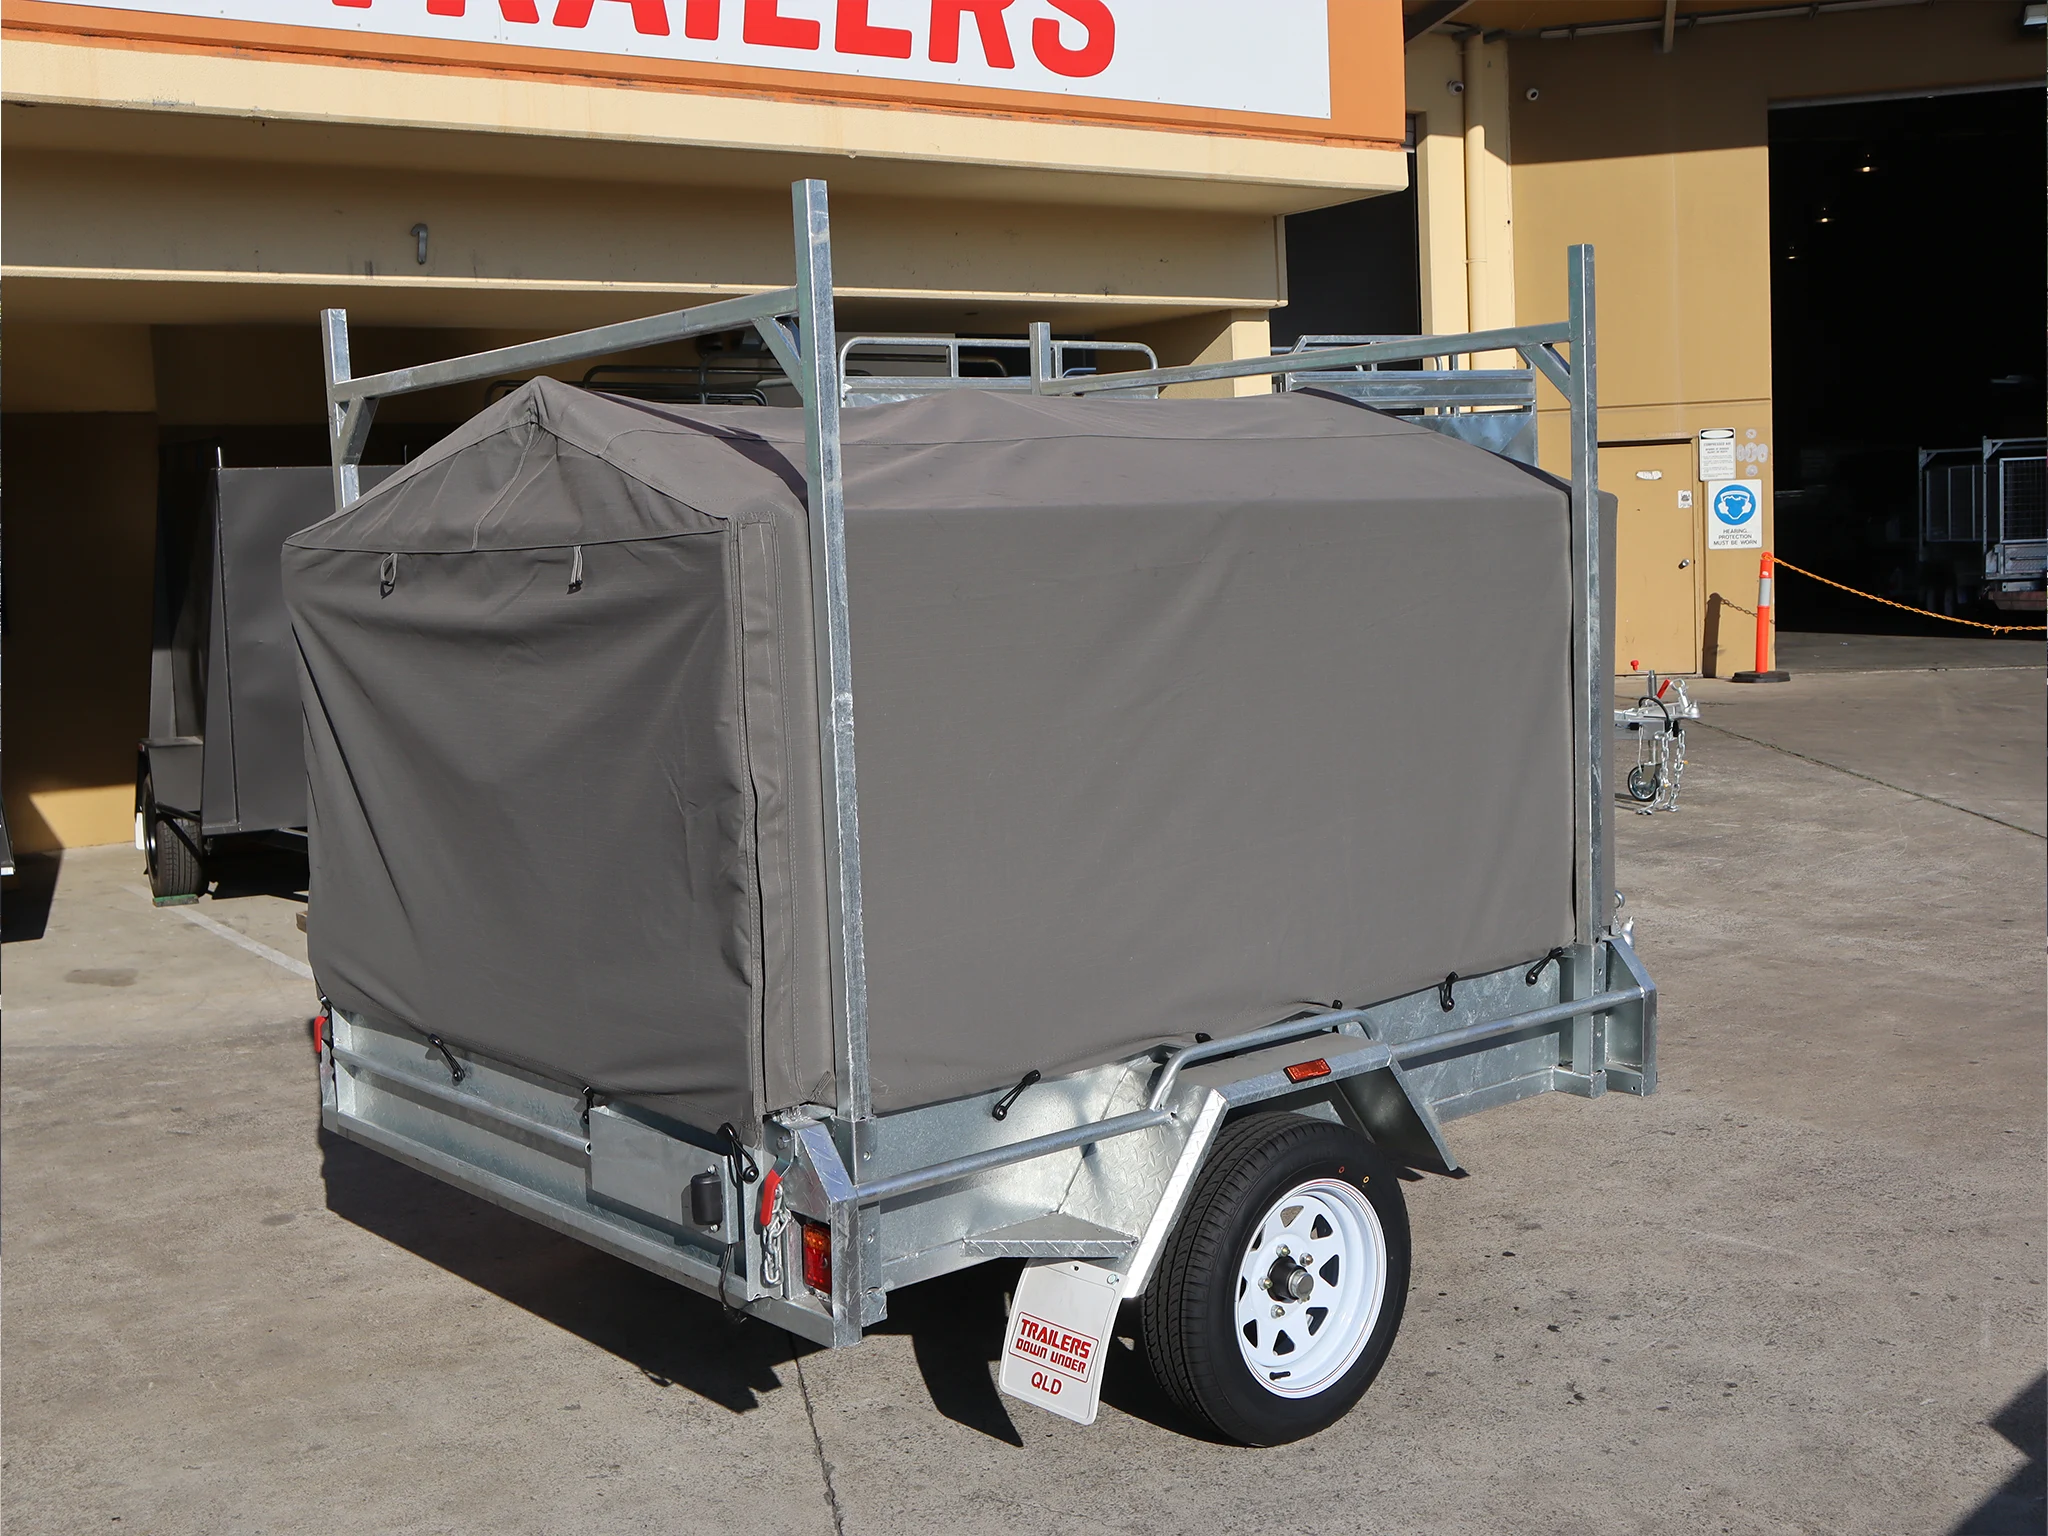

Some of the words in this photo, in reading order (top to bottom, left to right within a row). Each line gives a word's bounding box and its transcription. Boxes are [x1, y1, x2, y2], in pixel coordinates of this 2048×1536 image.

[1016, 1338, 1048, 1359] DOWN
[1050, 1351, 1087, 1374] UNDER
[1021, 1318, 1092, 1359] TRAILERS
[1031, 1371, 1062, 1395] QLD
